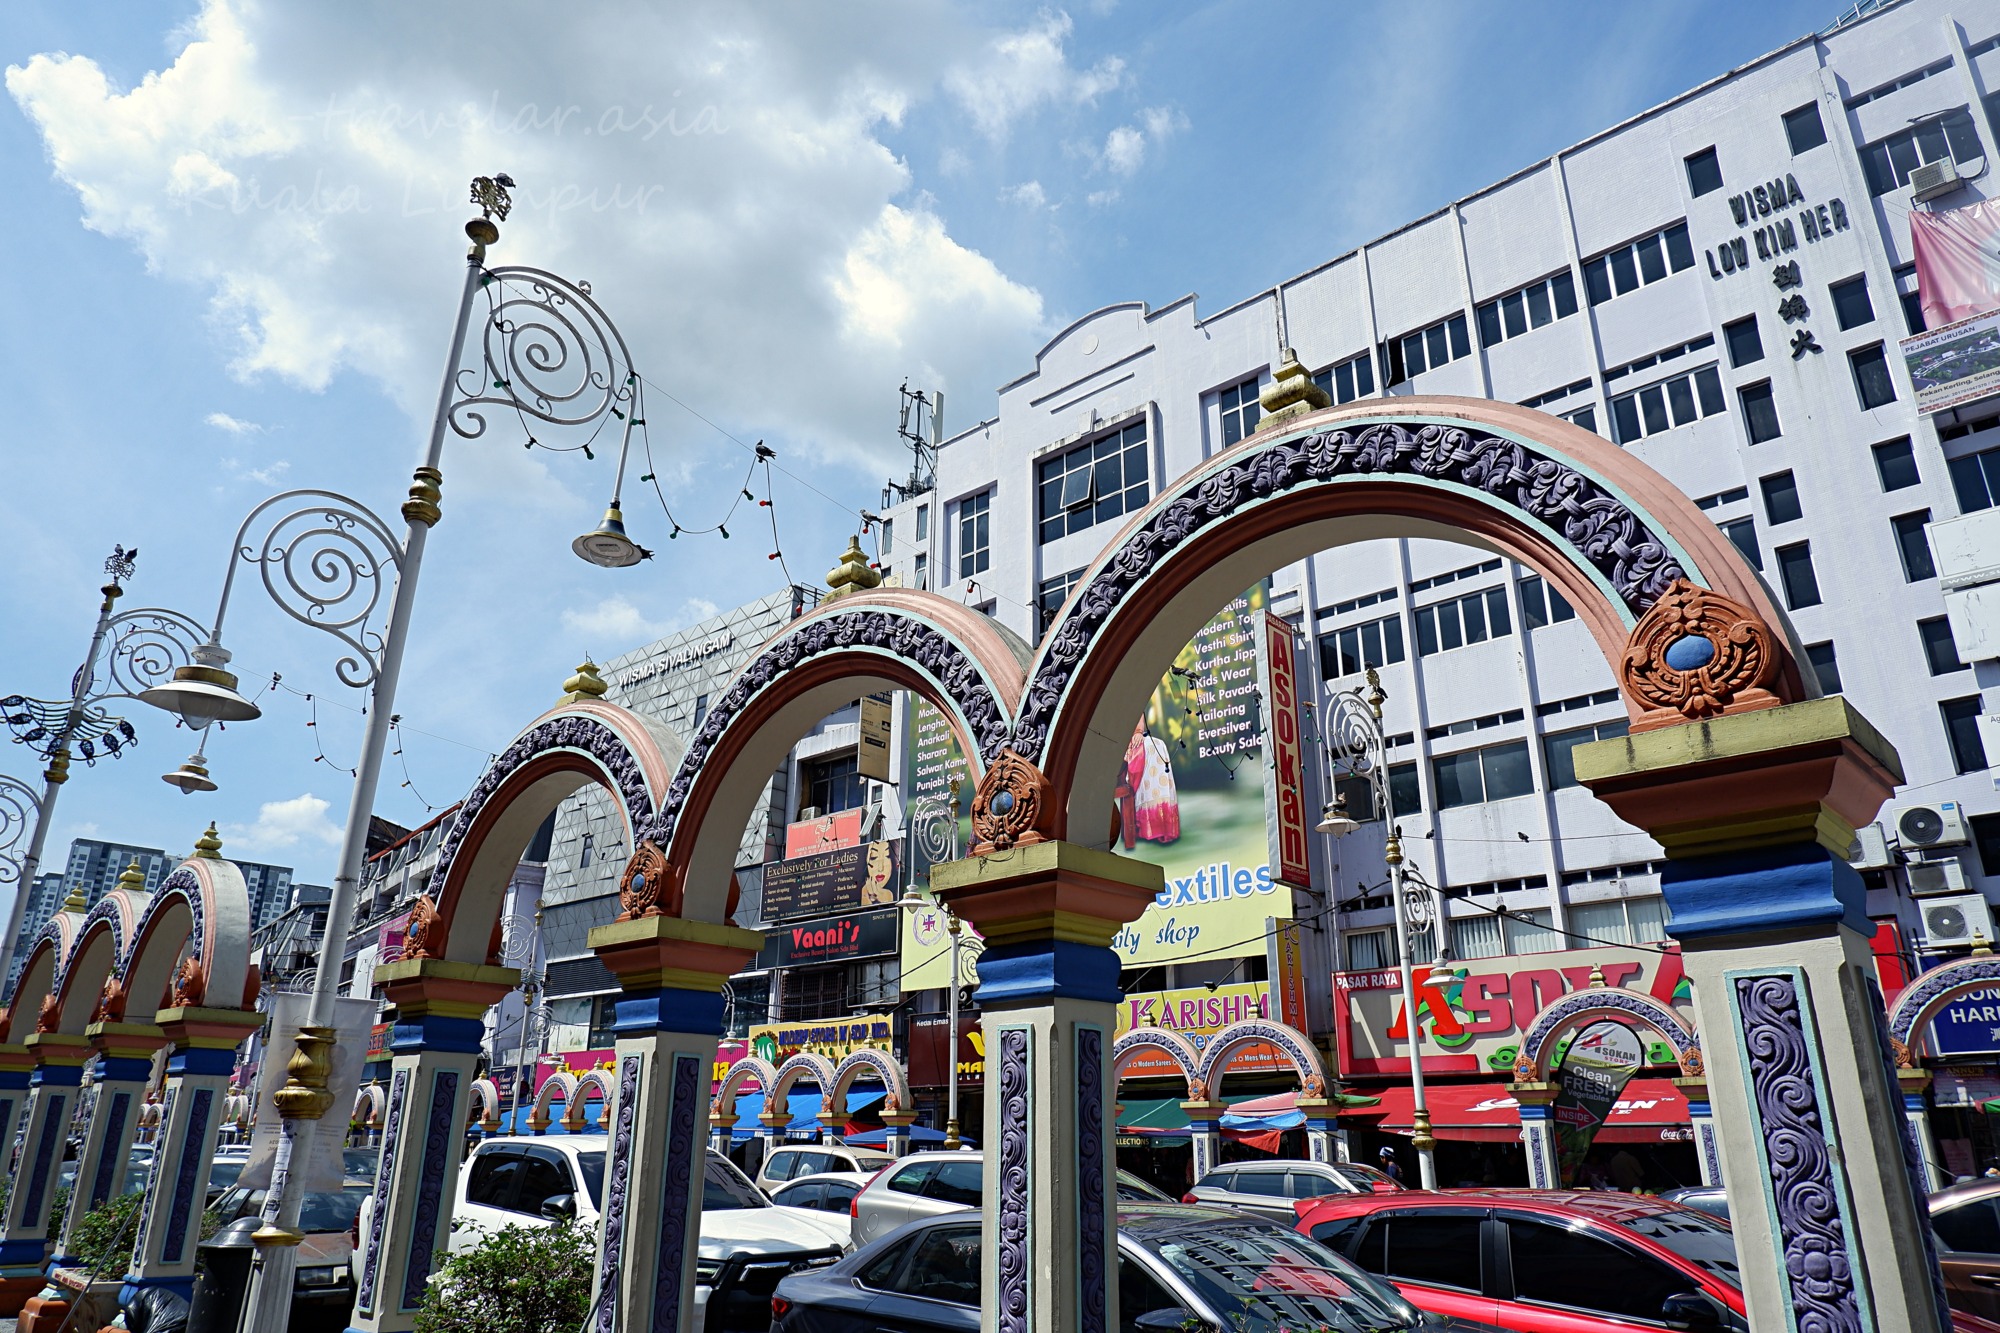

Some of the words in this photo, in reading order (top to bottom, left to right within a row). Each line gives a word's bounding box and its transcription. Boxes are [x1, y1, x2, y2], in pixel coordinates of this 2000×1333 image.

[1728, 172, 1804, 225] WISMA
[1705, 235, 1749, 278] LOW
[1752, 217, 1797, 260] KIM
[1799, 197, 1849, 242] HER
[1905, 337, 1940, 353] PEJABAT
[1940, 326, 1976, 341] URUSAN
[1919, 387, 1943, 398] Pekan
[1194, 619, 1234, 639] Modern
[1193, 635, 1227, 655] Vesthi
[620, 662, 656, 688] WISMA
[657, 632, 734, 673] SIVALINGAM
[1194, 653, 1231, 672] Kurtha
[1195, 675, 1218, 690] Kids
[1220, 666, 1252, 682] Wear
[1198, 703, 1246, 723] Tailoring
[918, 719, 946, 734] Lengha
[1198, 720, 1251, 741] Eversilver
[917, 730, 950, 748] Anarkali
[917, 747, 948, 762] Sharara
[1199, 741, 1236, 759] Beauty
[916, 763, 943, 777] Salwar
[916, 775, 945, 792] Punjabi
[766, 861, 813, 877] Exclusively
[813, 857, 828, 869] For
[830, 851, 859, 865] Ladies
[792, 920, 860, 951] Vaani's
[1155, 917, 1200, 948] shop
[1283, 922, 1299, 1029] KARISHMA
[1336, 975, 1368, 990] PASAR
[1371, 972, 1398, 987] RAYA
[916, 1019, 932, 1027] Kedai
[932, 1018, 949, 1026] Emas
[1137, 1060, 1155, 1068] Modern
[1155, 1059, 1172, 1067] Sarees
[1244, 1054, 1259, 1062] Mens
[1258, 1053, 1273, 1061] Wear
[1572, 1066, 1612, 1083] Clean
[1563, 1075, 1616, 1097] FRESH
[1567, 1088, 1610, 1103] Vegetables
[1558, 1110, 1590, 1122] INSIDE
